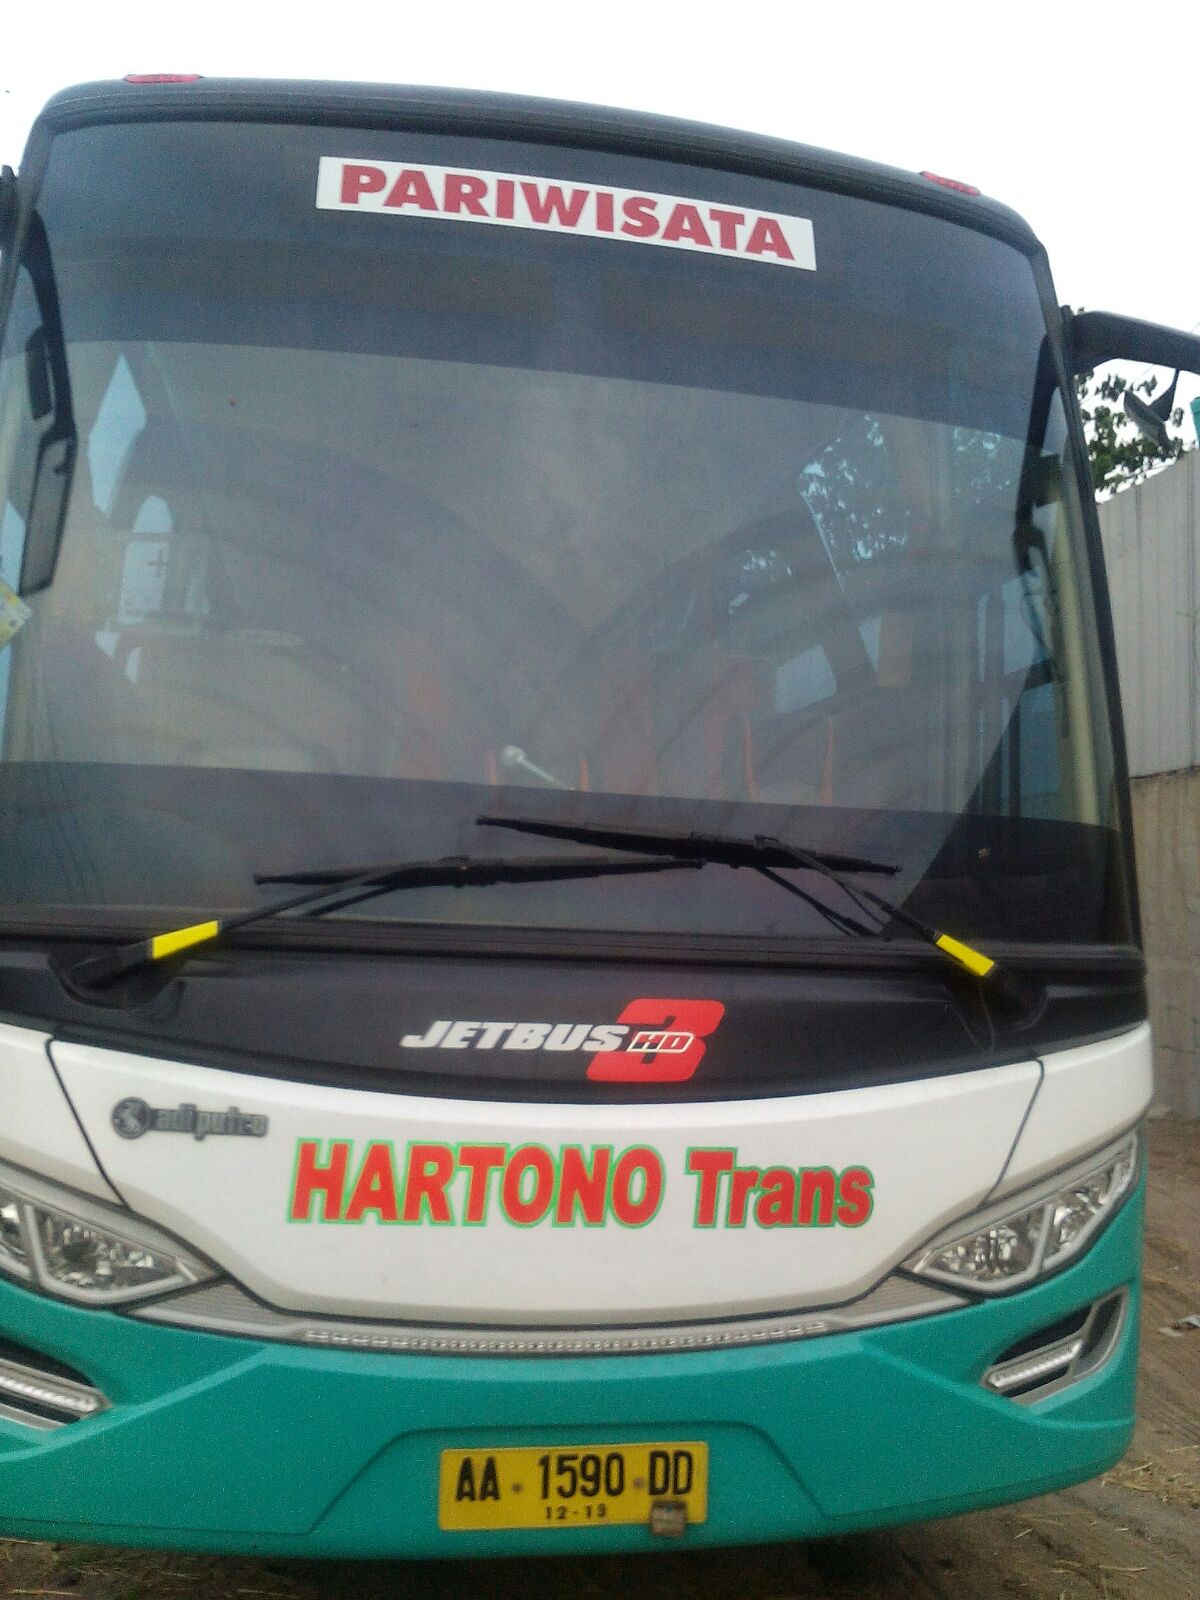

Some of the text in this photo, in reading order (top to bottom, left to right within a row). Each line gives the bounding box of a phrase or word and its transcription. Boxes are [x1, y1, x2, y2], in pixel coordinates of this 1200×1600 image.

[340, 164, 795, 261] PARIWISATA
[400, 1020, 630, 1051] JETBUS
[287, 1137, 876, 1229] HARTONO Trans
[455, 1450, 693, 1502] AA 1590 DD
